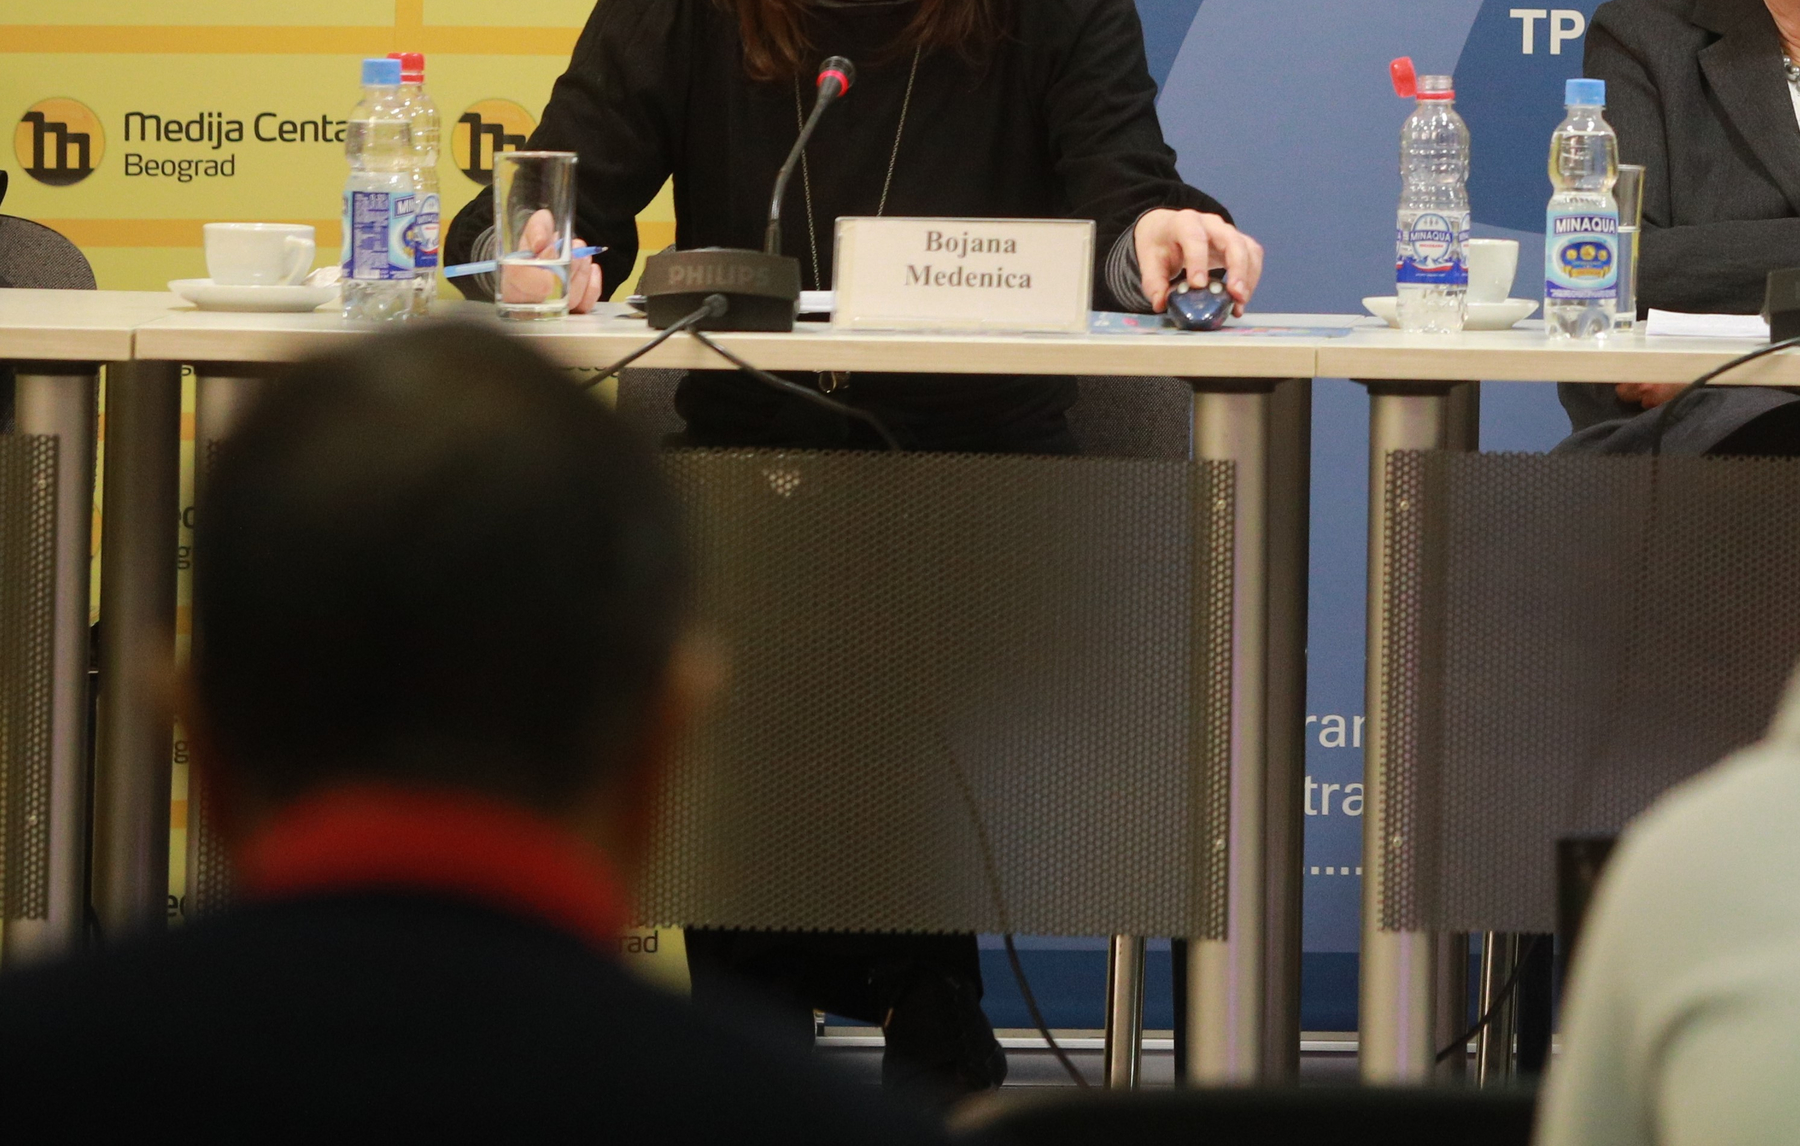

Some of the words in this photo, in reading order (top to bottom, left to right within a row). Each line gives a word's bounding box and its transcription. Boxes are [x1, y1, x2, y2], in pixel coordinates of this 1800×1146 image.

[124, 111, 244, 150] Medija
[253, 111, 348, 143] Centa
[124, 153, 235, 183] Beograd
[1410, 230, 1451, 242] MINAQUA
[1555, 217, 1616, 234] MINAQUA
[925, 230, 1016, 258] Bojana
[668, 264, 771, 285] PHILIPS
[906, 264, 1032, 289] Medenica
